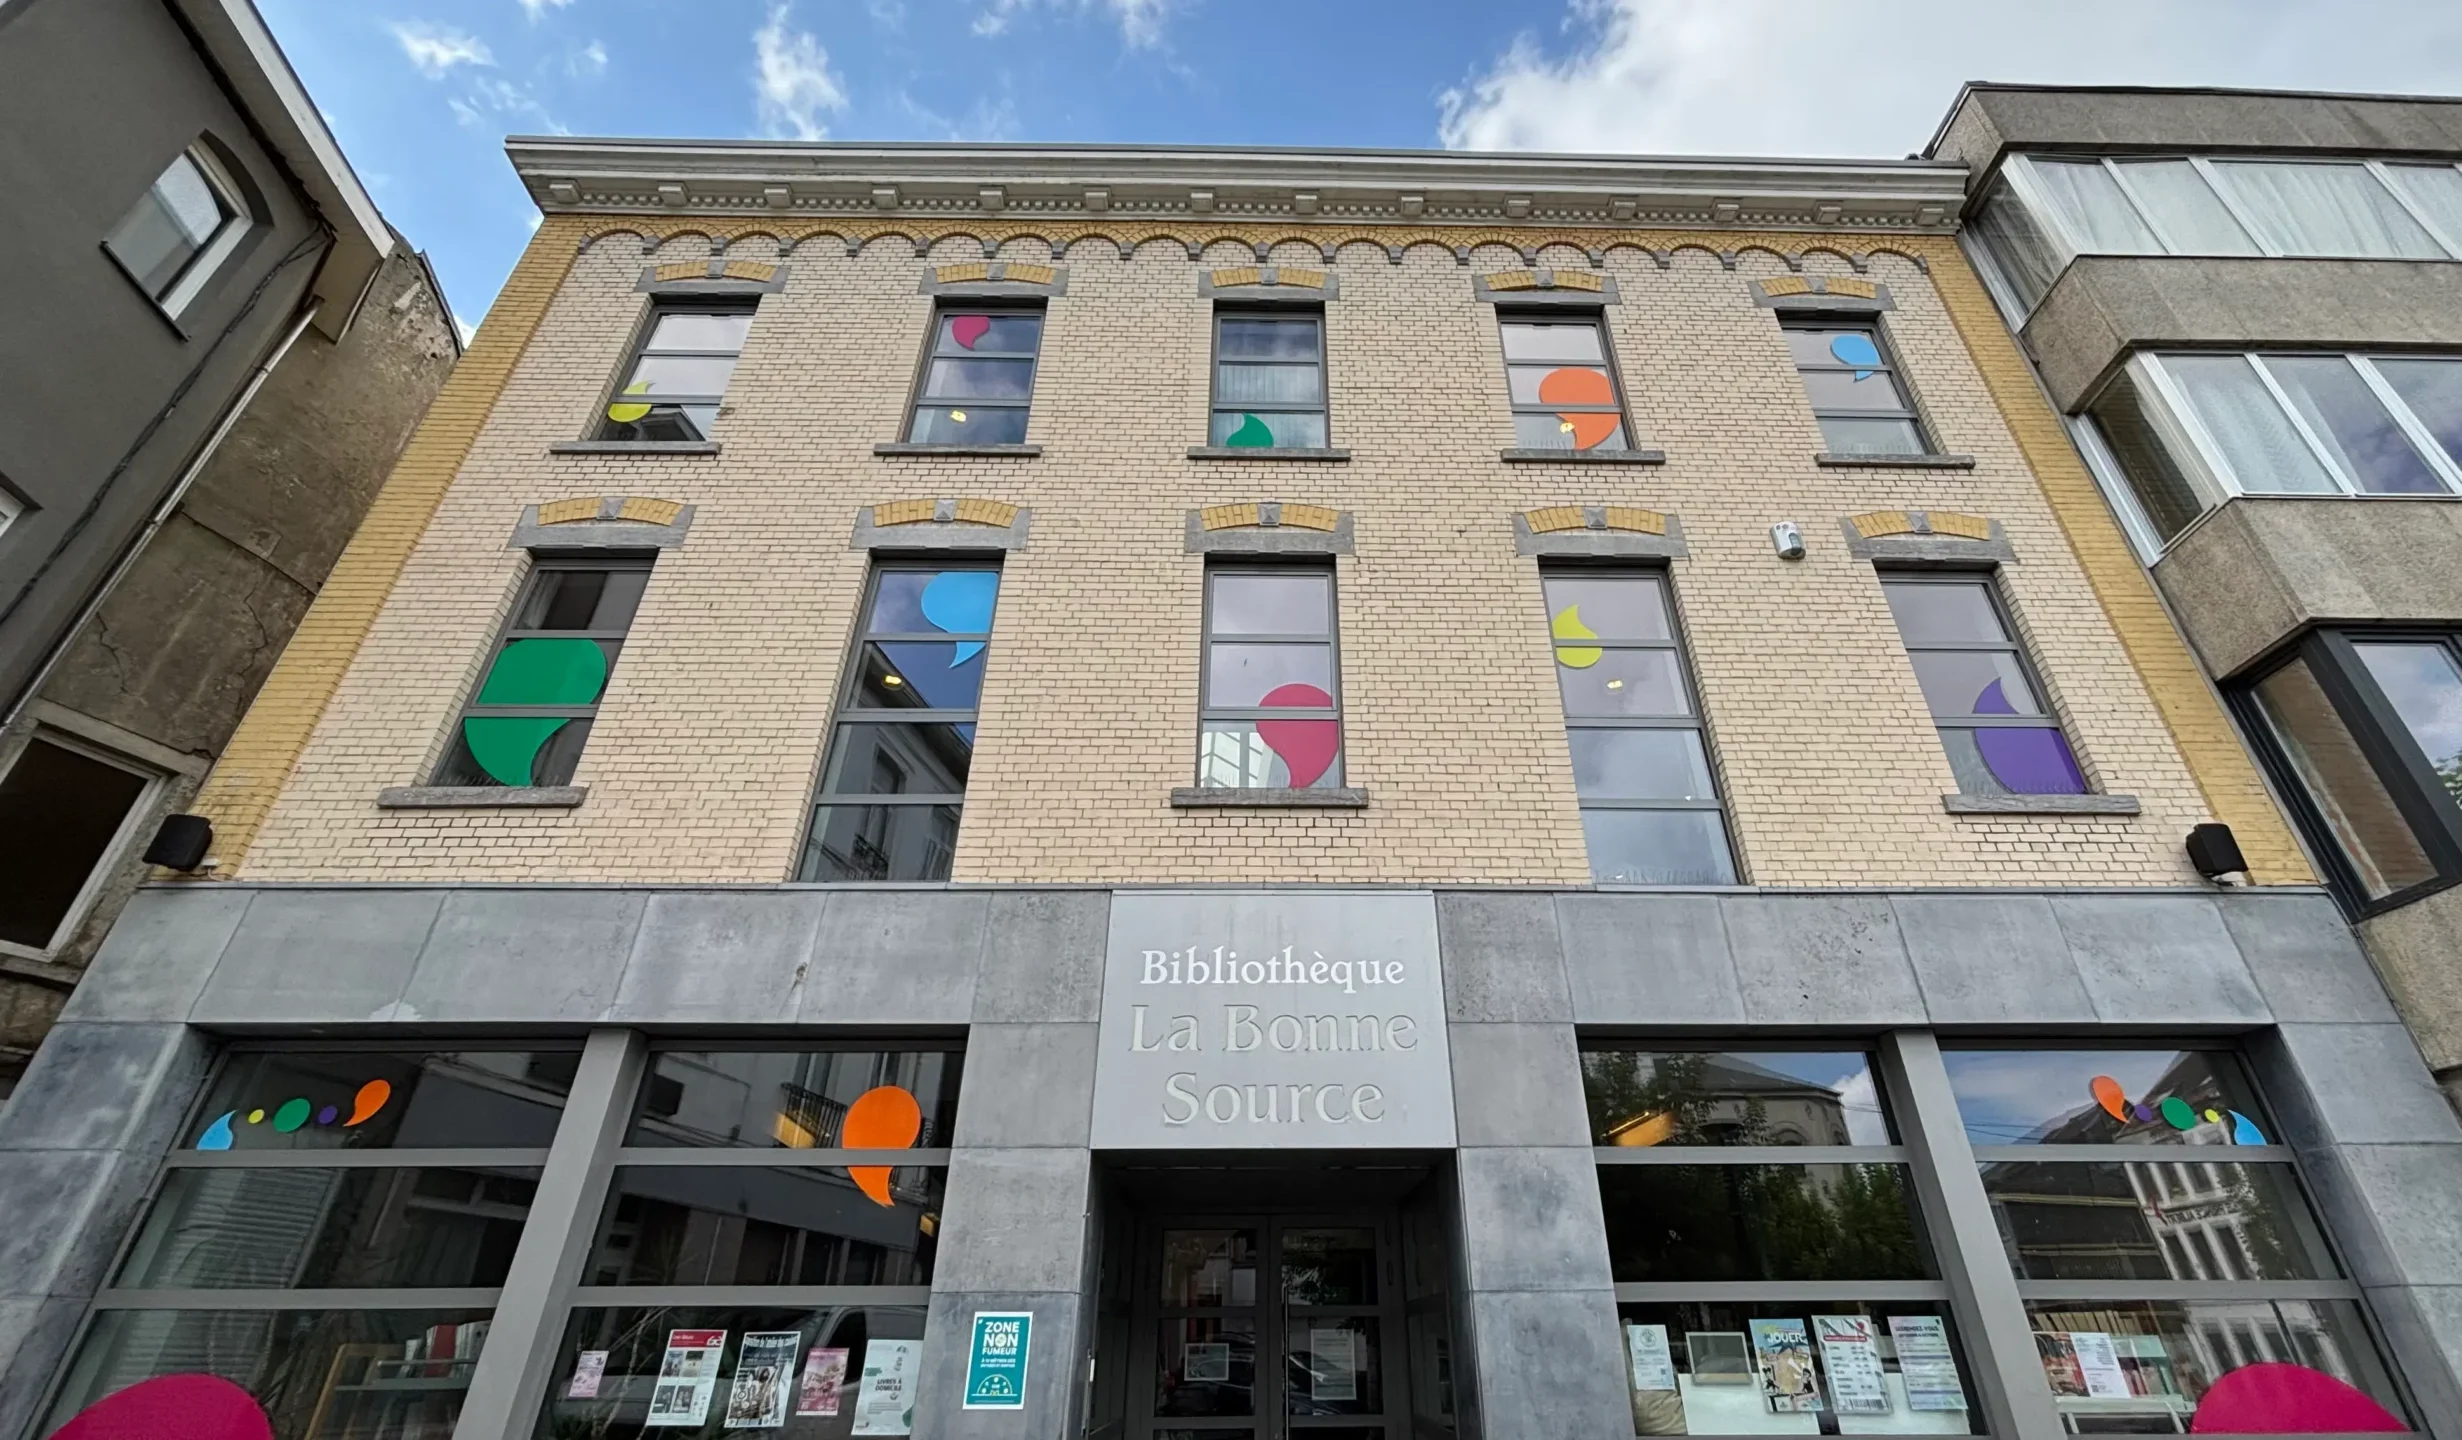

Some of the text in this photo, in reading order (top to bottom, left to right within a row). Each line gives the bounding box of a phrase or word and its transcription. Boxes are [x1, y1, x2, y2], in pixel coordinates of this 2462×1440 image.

[1140, 945, 1404, 993] Bibliothèque
[1128, 1004, 1418, 1052] La Bonne
[1162, 1071, 1385, 1126] Source
[984, 1321, 1020, 1333] ZONE
[983, 1333, 1018, 1348] NON
[1767, 1332, 1804, 1343] JOUER
[982, 1347, 1017, 1355] FUMEUR
